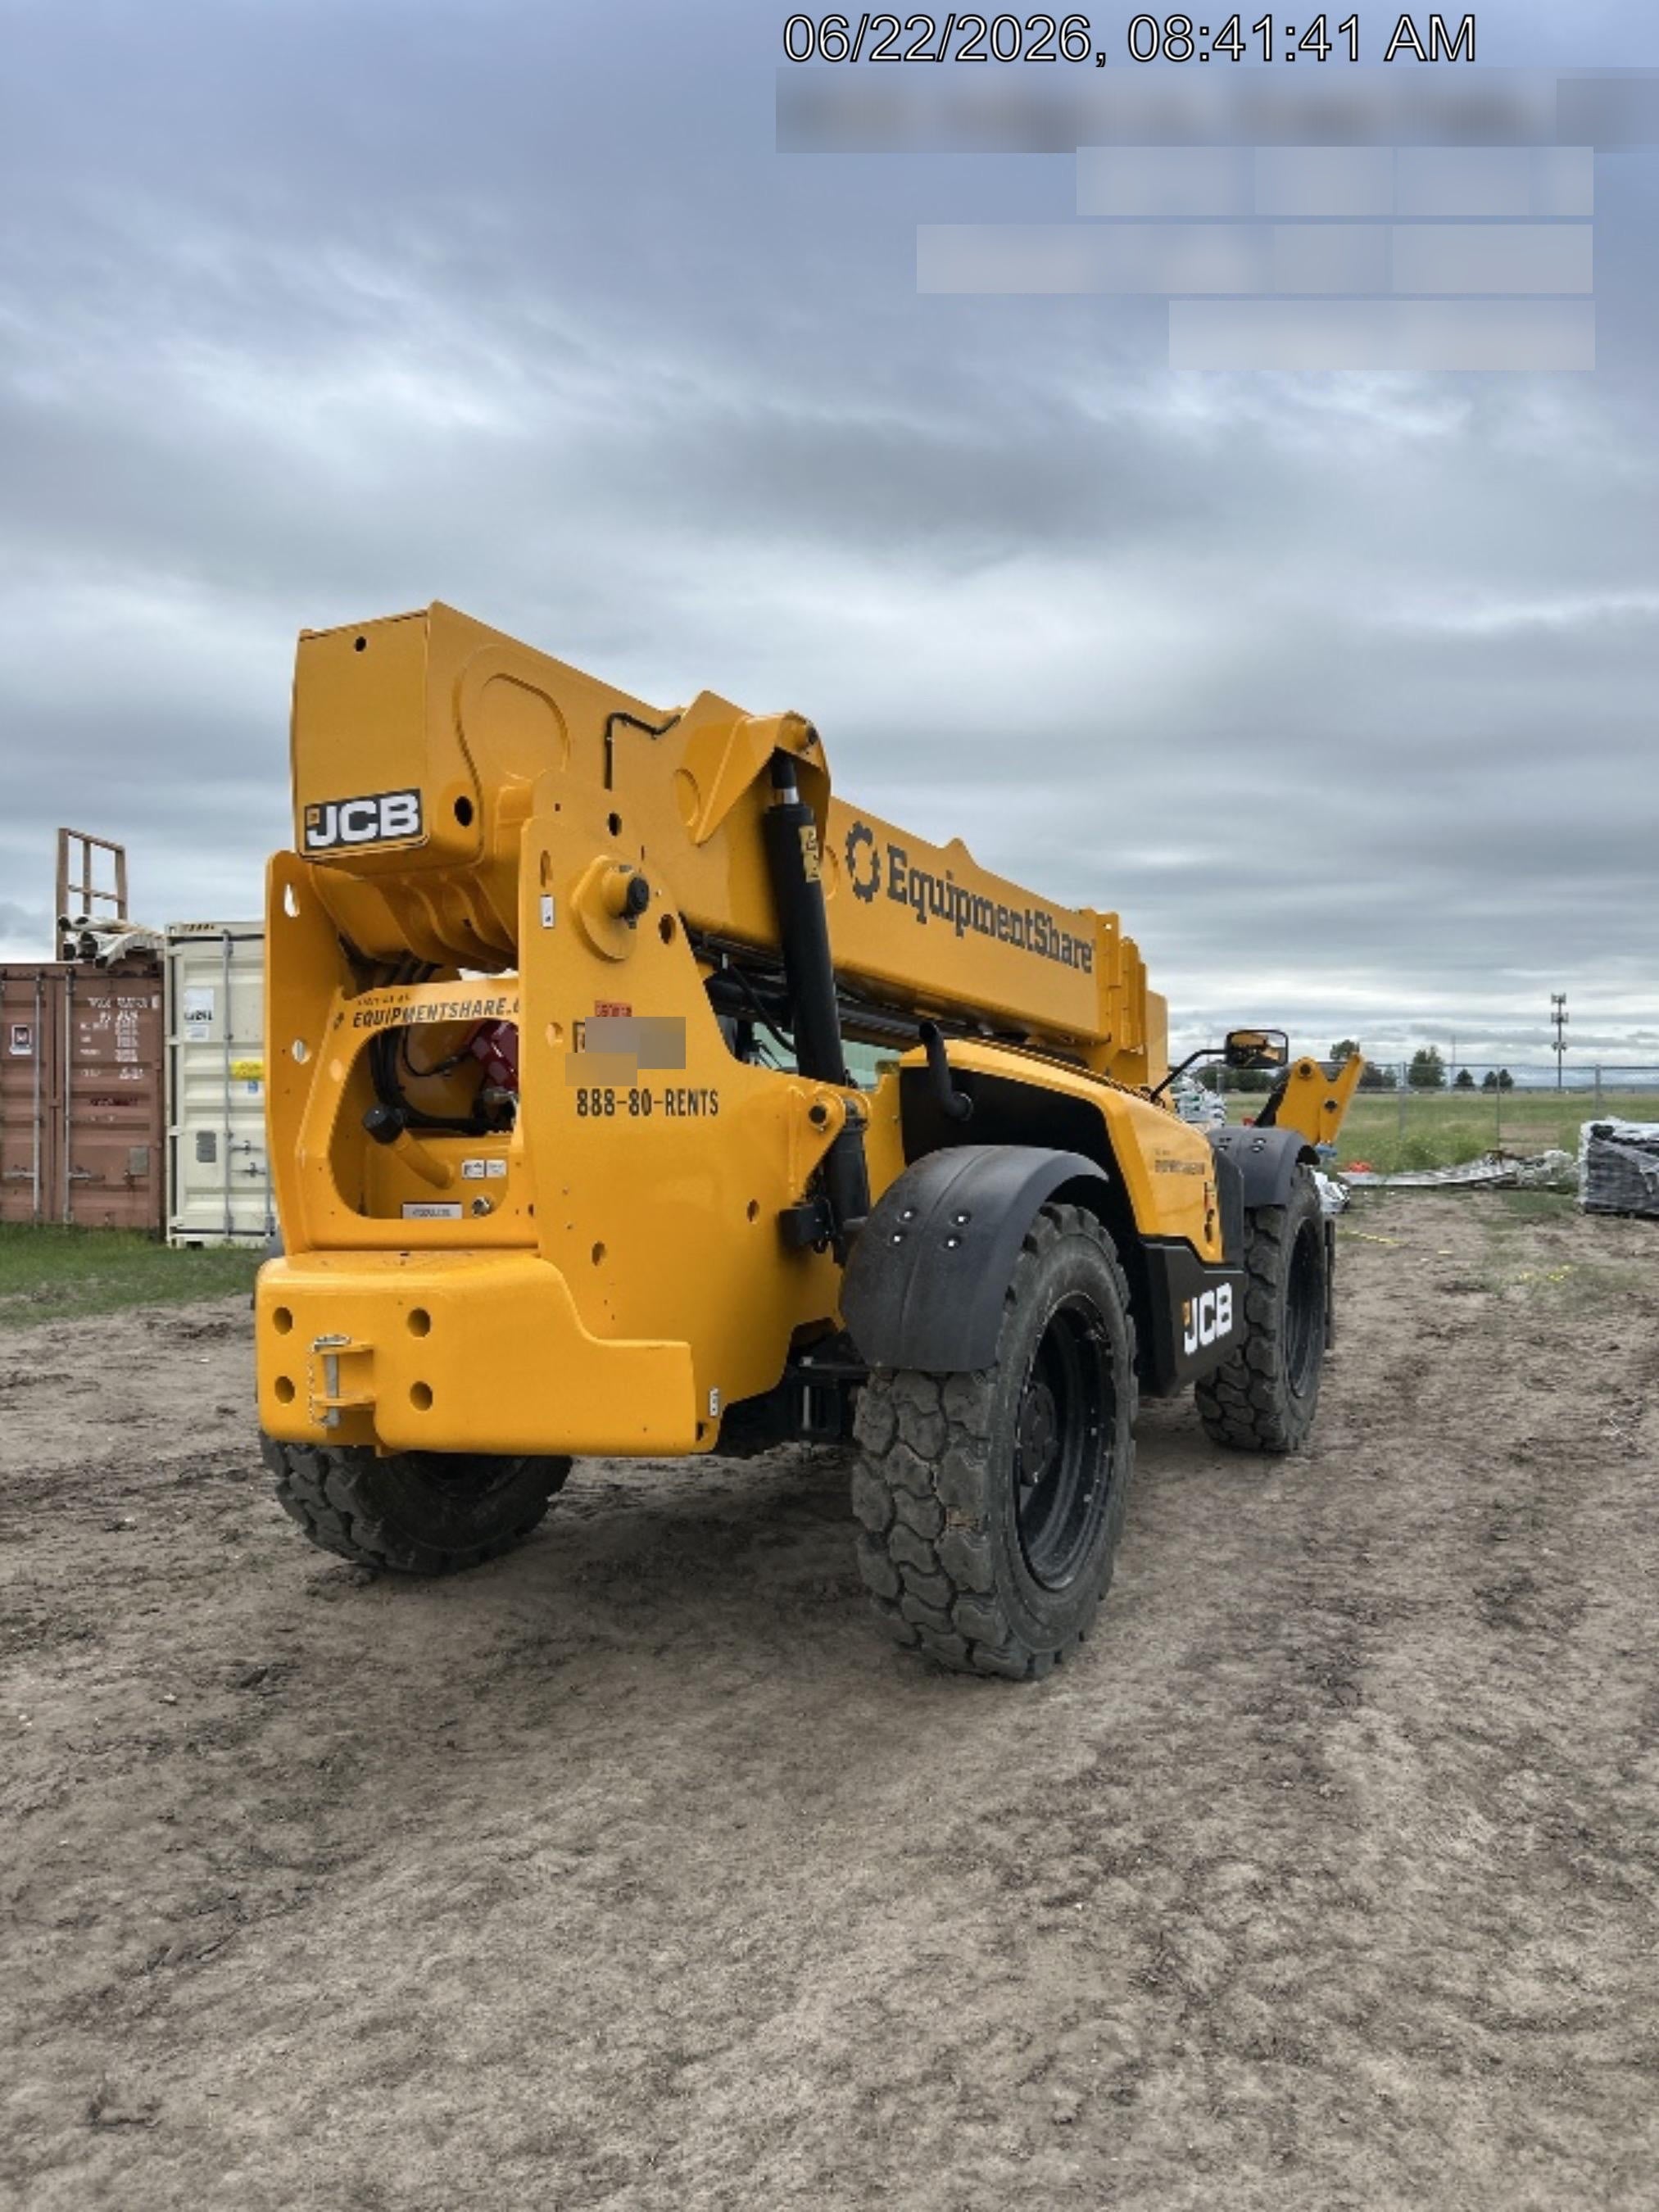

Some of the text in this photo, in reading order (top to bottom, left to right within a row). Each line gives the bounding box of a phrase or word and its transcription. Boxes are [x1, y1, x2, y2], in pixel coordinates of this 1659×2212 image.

[306, 793, 419, 847] JCB
[886, 841, 1093, 973] EquipmentShare
[576, 1088, 719, 1117] 888-80-RENTS
[1182, 1281, 1233, 1356] JCB
